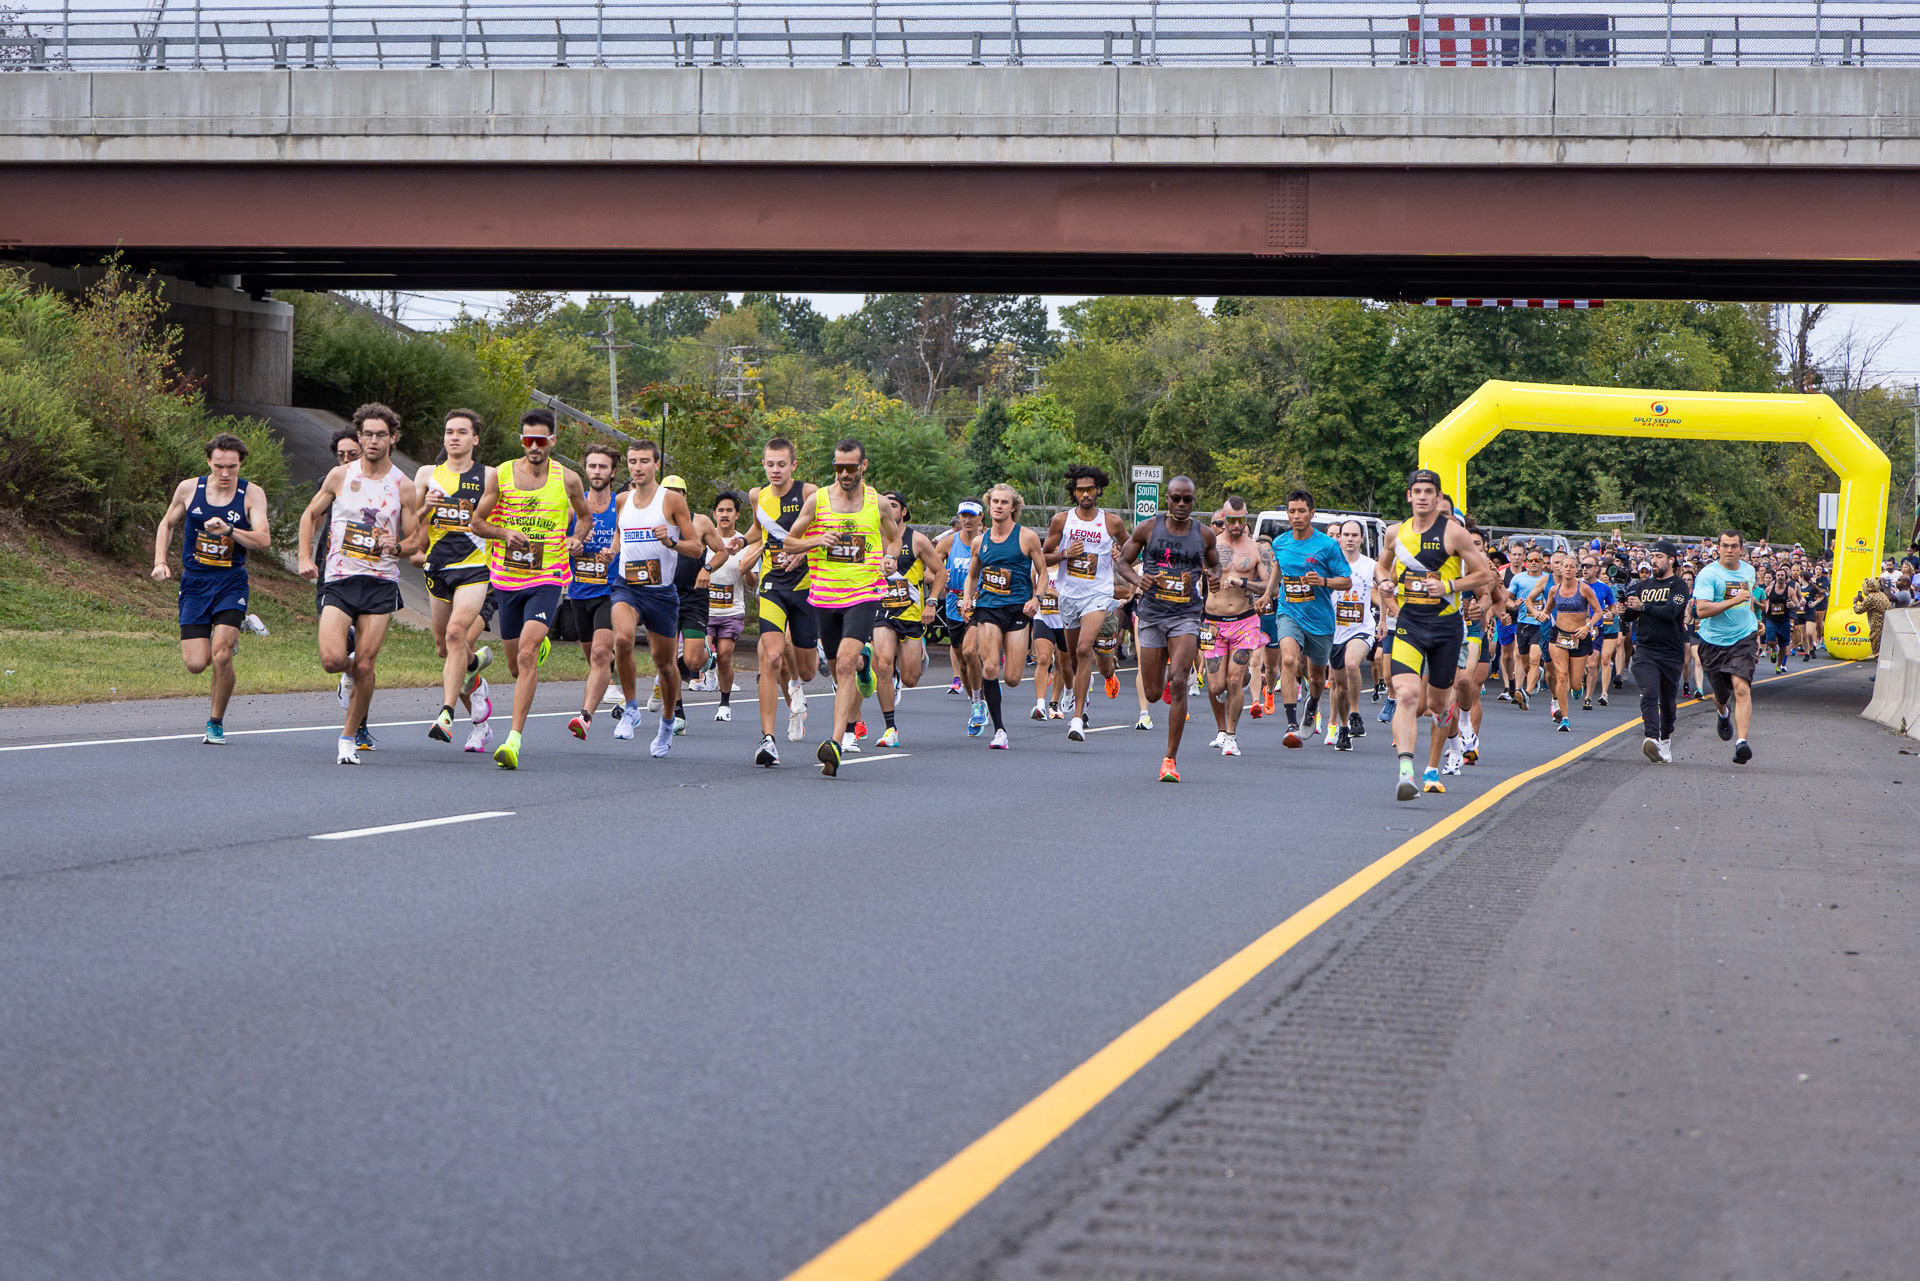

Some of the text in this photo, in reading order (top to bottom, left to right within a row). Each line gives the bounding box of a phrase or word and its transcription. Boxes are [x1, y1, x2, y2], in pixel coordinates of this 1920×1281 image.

[1135, 470, 1159, 478] BY-PASS
[461, 482, 480, 491] GSTC
[1138, 486, 1156, 496] SOUTH
[782, 504, 800, 513] GSTC
[1139, 503, 1155, 513] 206
[227, 510, 241, 523] SP
[437, 507, 470, 520] 205
[624, 531, 644, 540] SHORE
[1069, 529, 1102, 540] LEONIA
[352, 534, 376, 547] 39
[201, 543, 228, 554] 137
[832, 546, 860, 556] 217
[1423, 542, 1441, 550] GSTC
[512, 551, 534, 562] 94
[577, 562, 605, 573] 228
[1074, 560, 1091, 569] 27
[637, 570, 649, 580] 9
[985, 574, 1007, 584] 198
[1166, 580, 1185, 591] 75
[1285, 584, 1311, 593] 233
[1340, 610, 1361, 618] 212
